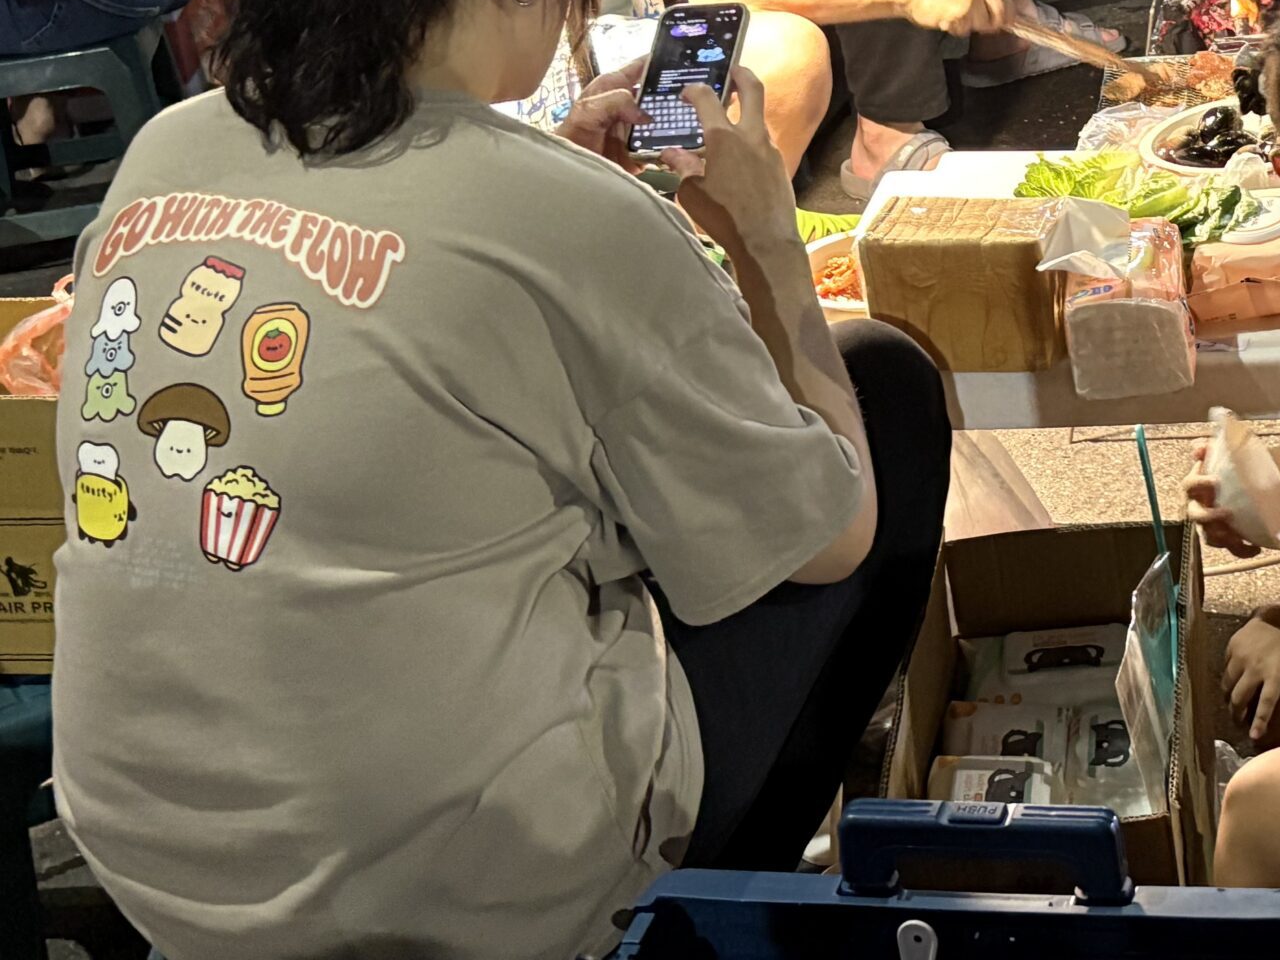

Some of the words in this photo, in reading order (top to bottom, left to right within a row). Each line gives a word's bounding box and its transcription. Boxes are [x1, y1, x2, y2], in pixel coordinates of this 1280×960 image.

[93, 198, 157, 276] GO
[151, 194, 234, 241] WITH
[236, 199, 296, 248] THE
[290, 212, 403, 306] FLOW
[956, 805, 998, 815] PUSH
